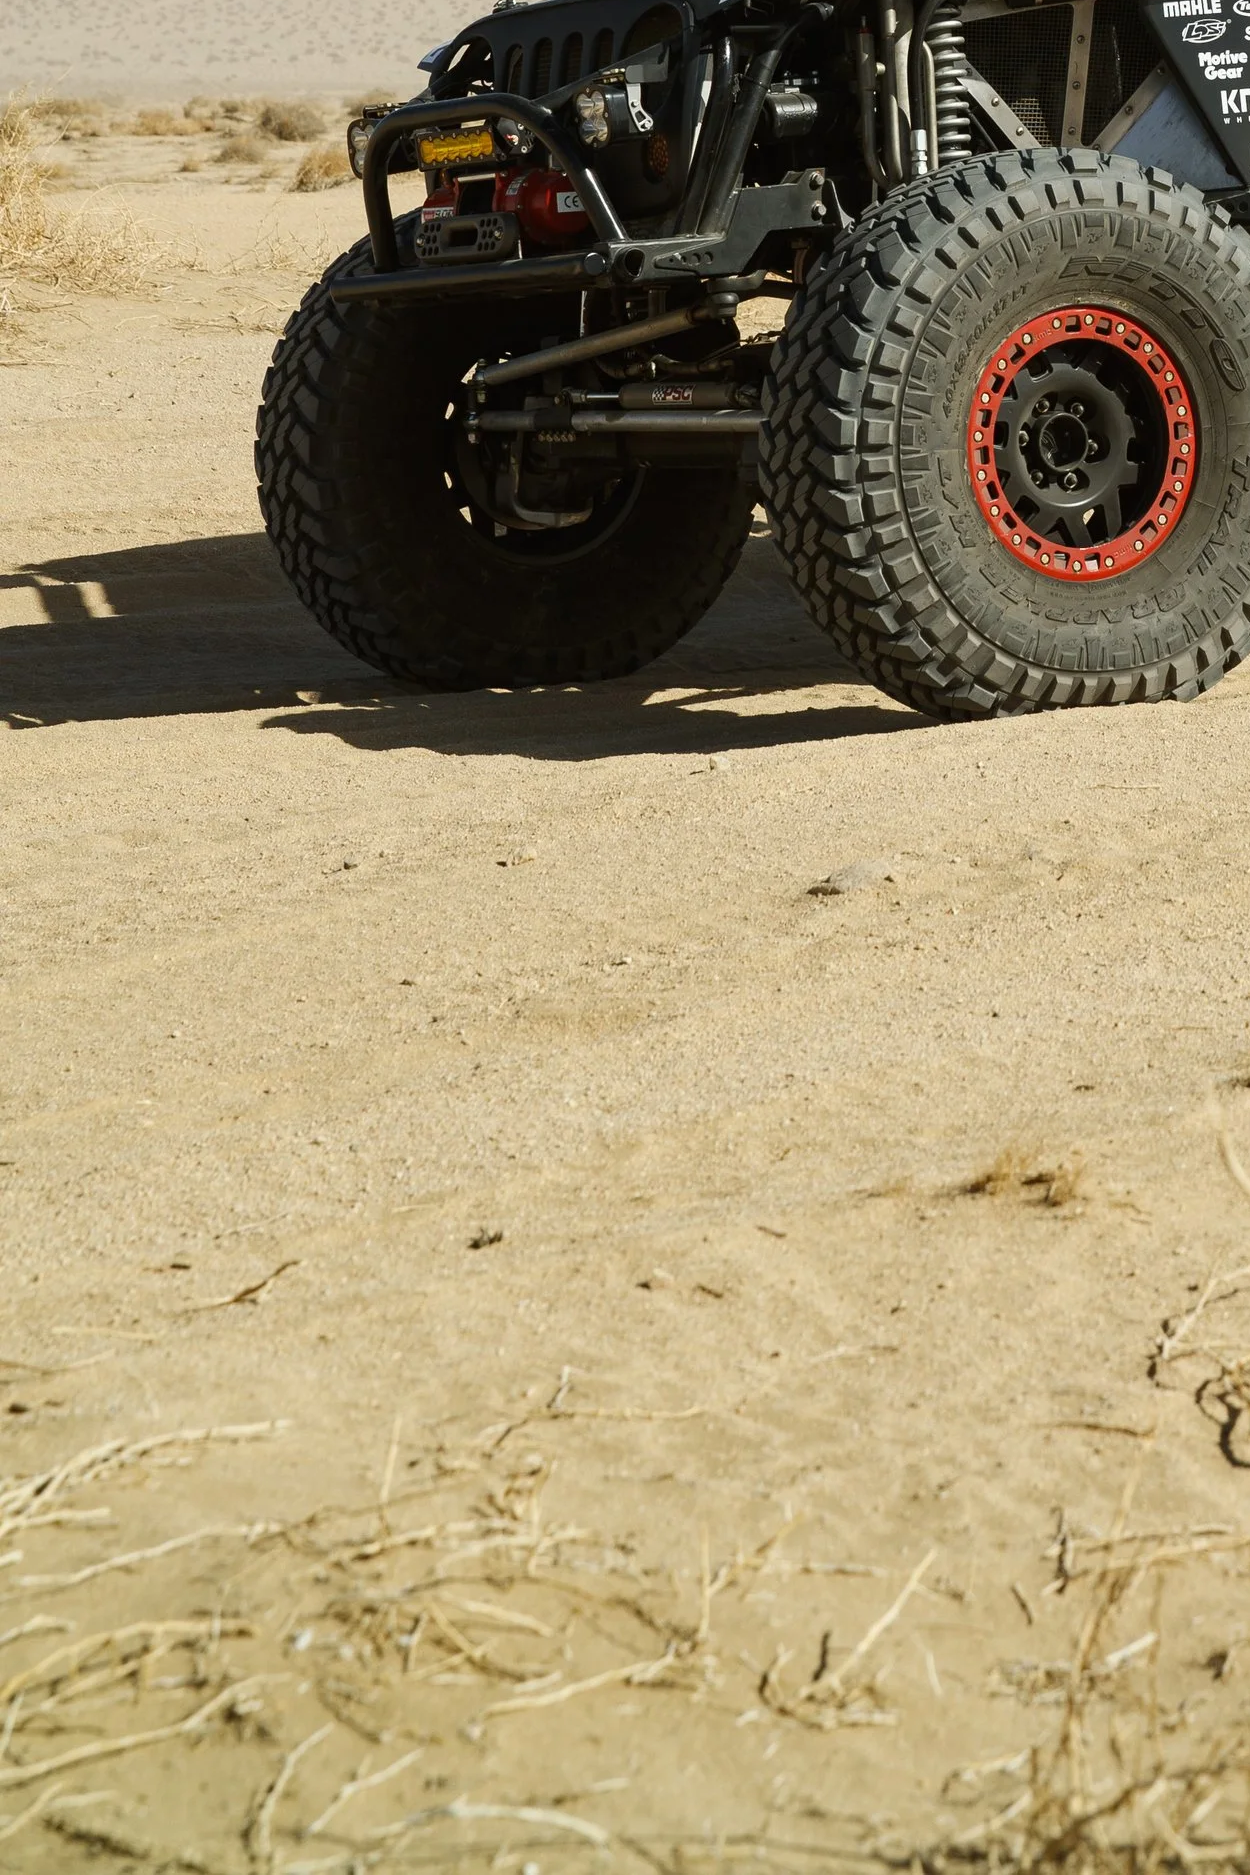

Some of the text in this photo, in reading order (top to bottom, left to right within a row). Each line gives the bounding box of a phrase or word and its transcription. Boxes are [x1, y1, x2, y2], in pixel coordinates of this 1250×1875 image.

[1198, 50, 1249, 67] Motive
[1204, 65, 1244, 80] Gear
[1058, 255, 1247, 392] NITTO
